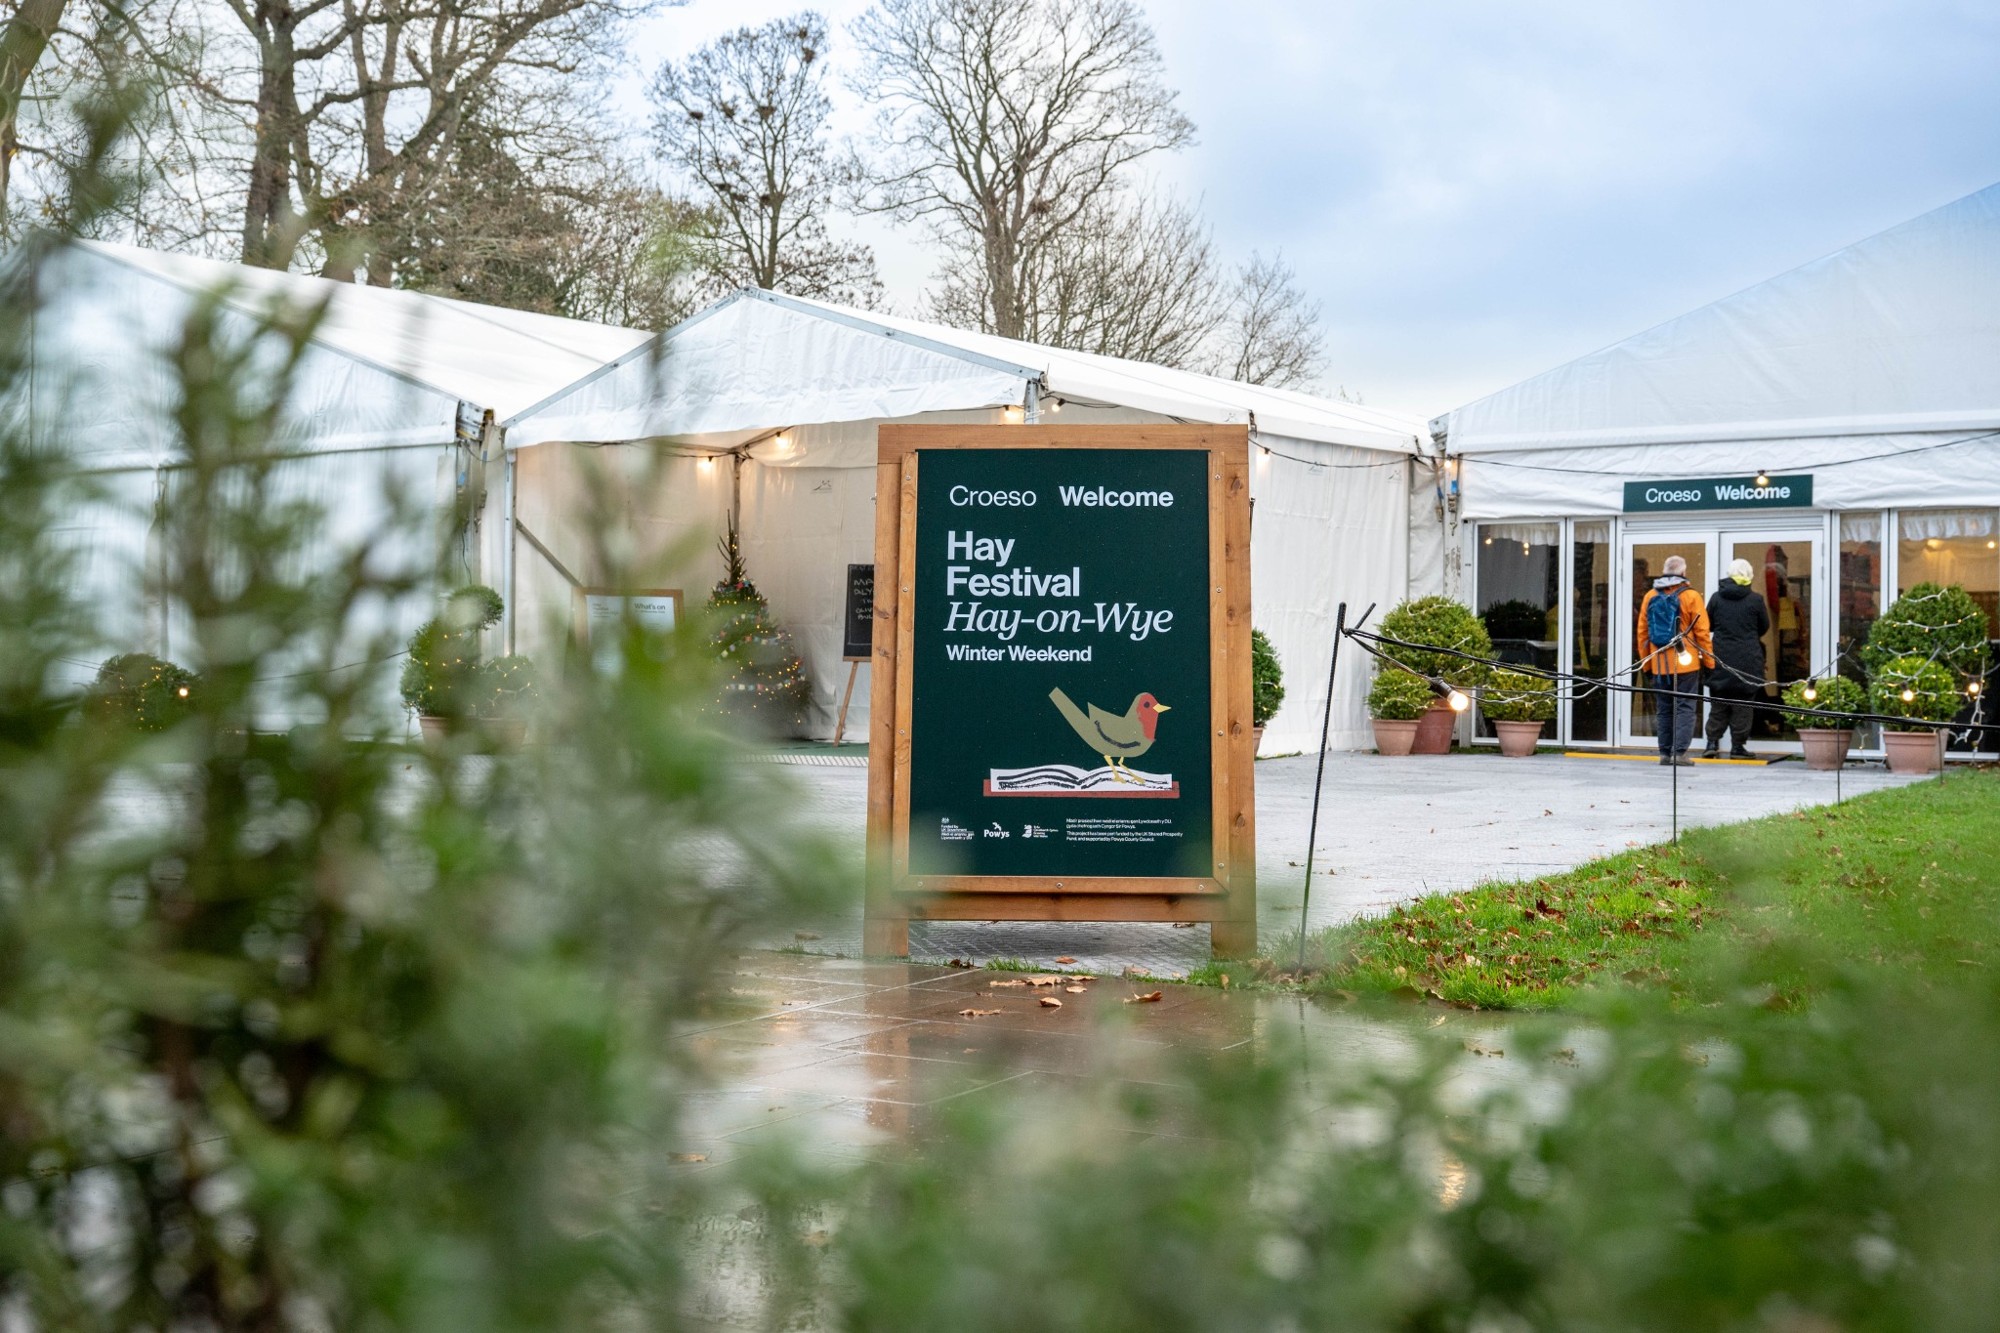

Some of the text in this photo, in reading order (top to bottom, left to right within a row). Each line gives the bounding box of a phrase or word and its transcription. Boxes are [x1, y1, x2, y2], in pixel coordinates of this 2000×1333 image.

[949, 485, 1174, 507] Croeso Welcome
[1645, 485, 1790, 503] Croeso Welcome
[947, 530, 1015, 566] Hay
[947, 566, 1080, 597] Festival
[943, 601, 1174, 641] Hay-on-Wye
[946, 645, 1092, 662] Winter Weekend
[984, 829, 1010, 839] Powys
